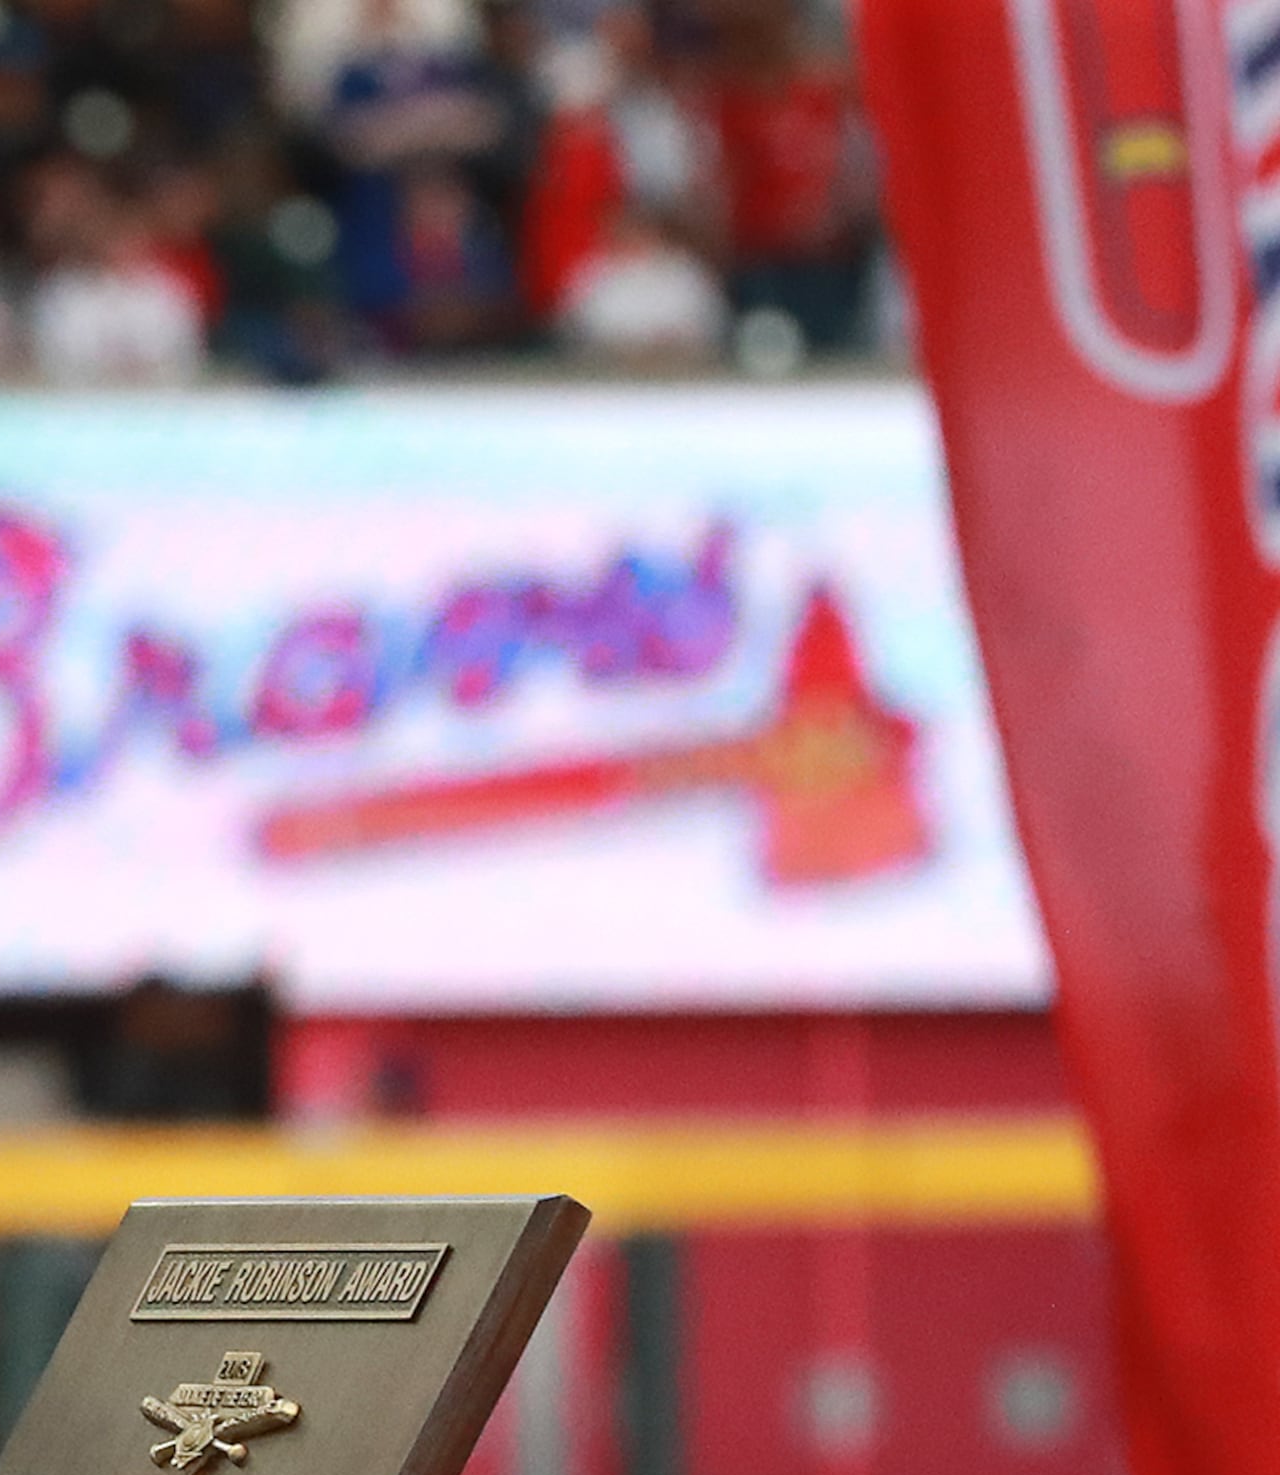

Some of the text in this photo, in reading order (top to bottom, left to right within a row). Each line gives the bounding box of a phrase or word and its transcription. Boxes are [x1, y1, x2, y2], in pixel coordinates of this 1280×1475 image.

[146, 1259, 429, 1304] JACKIE ROBINSON AWARD
